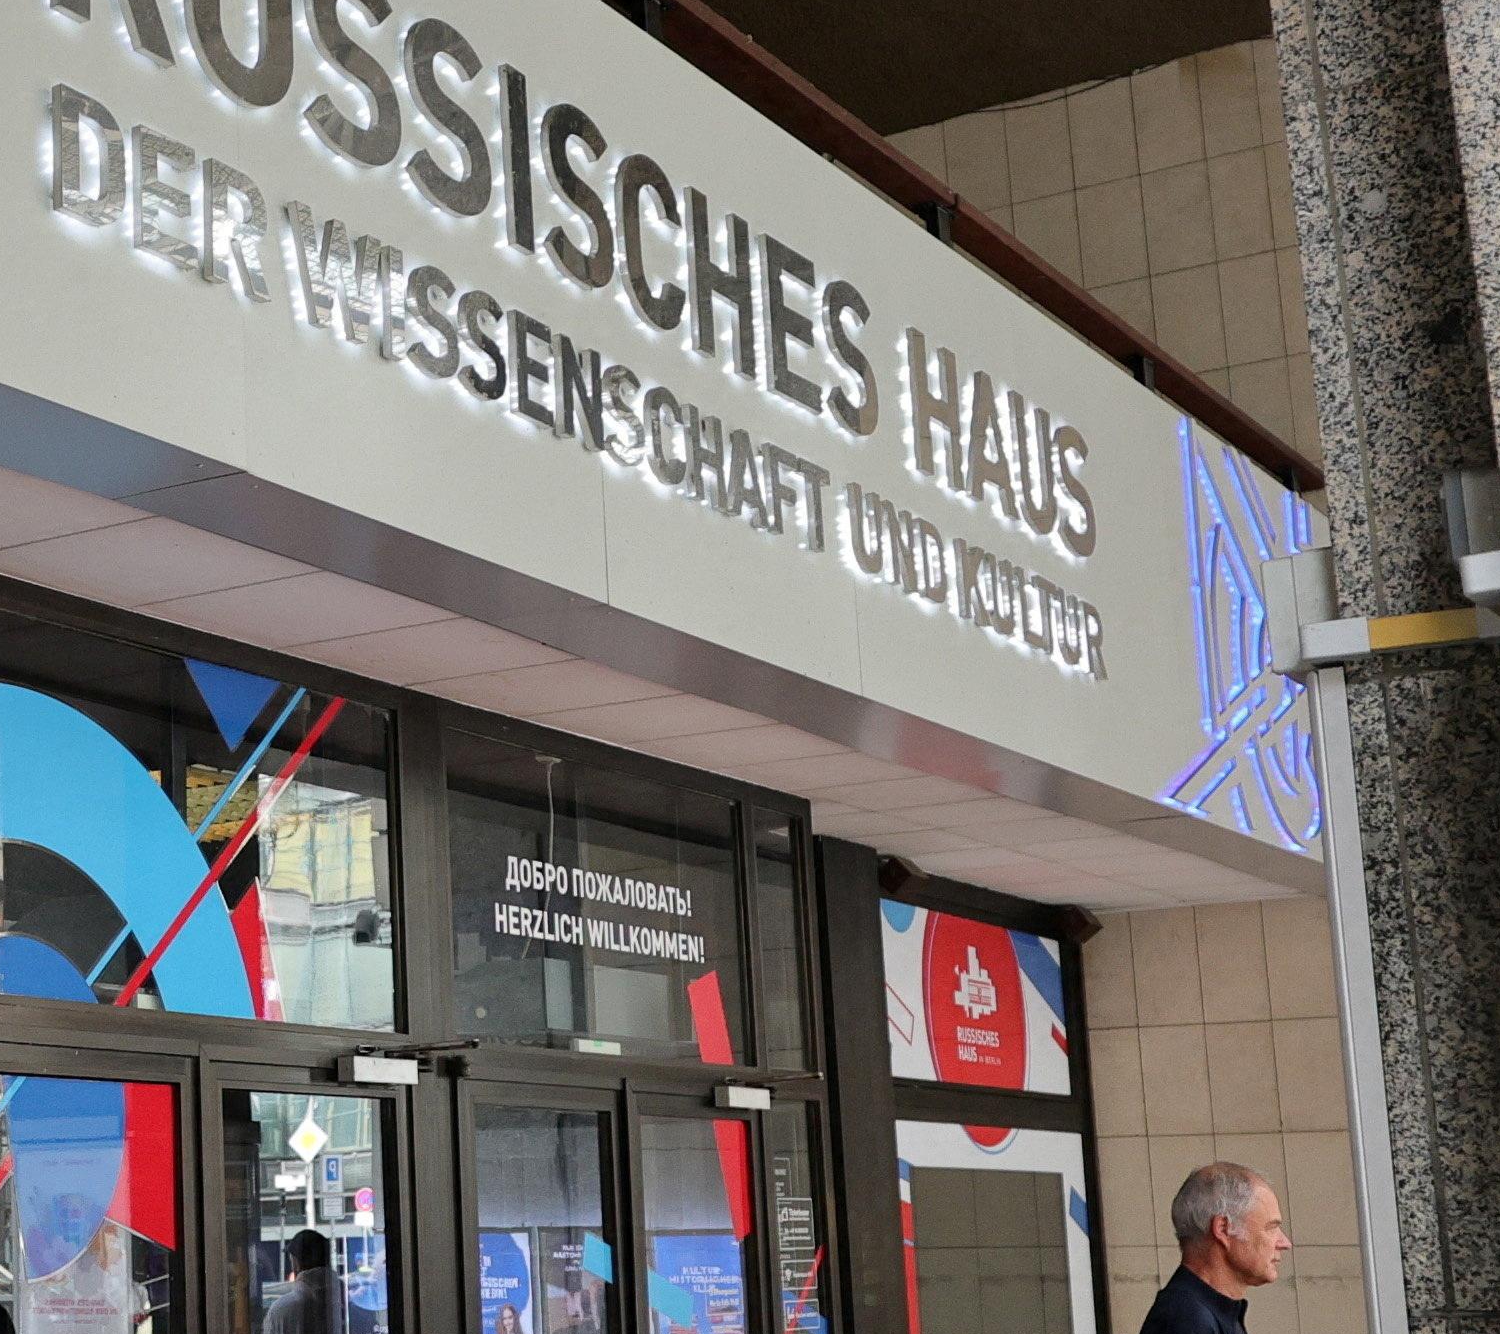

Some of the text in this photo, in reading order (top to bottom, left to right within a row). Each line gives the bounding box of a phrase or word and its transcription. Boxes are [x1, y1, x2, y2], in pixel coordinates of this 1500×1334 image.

[50, 83, 1110, 680] DER WISSENSCHAFT UND KULTUR
[904, 327, 1098, 559] HAUS
[505, 855, 692, 917] ДОБРО ПОЖАЛОВАТЬ!
[494, 902, 705, 964] HERZLICH WILLKOMMEN!
[957, 1026, 1000, 1047] RUSSISCHES
[958, 1044, 978, 1063] HAUS
